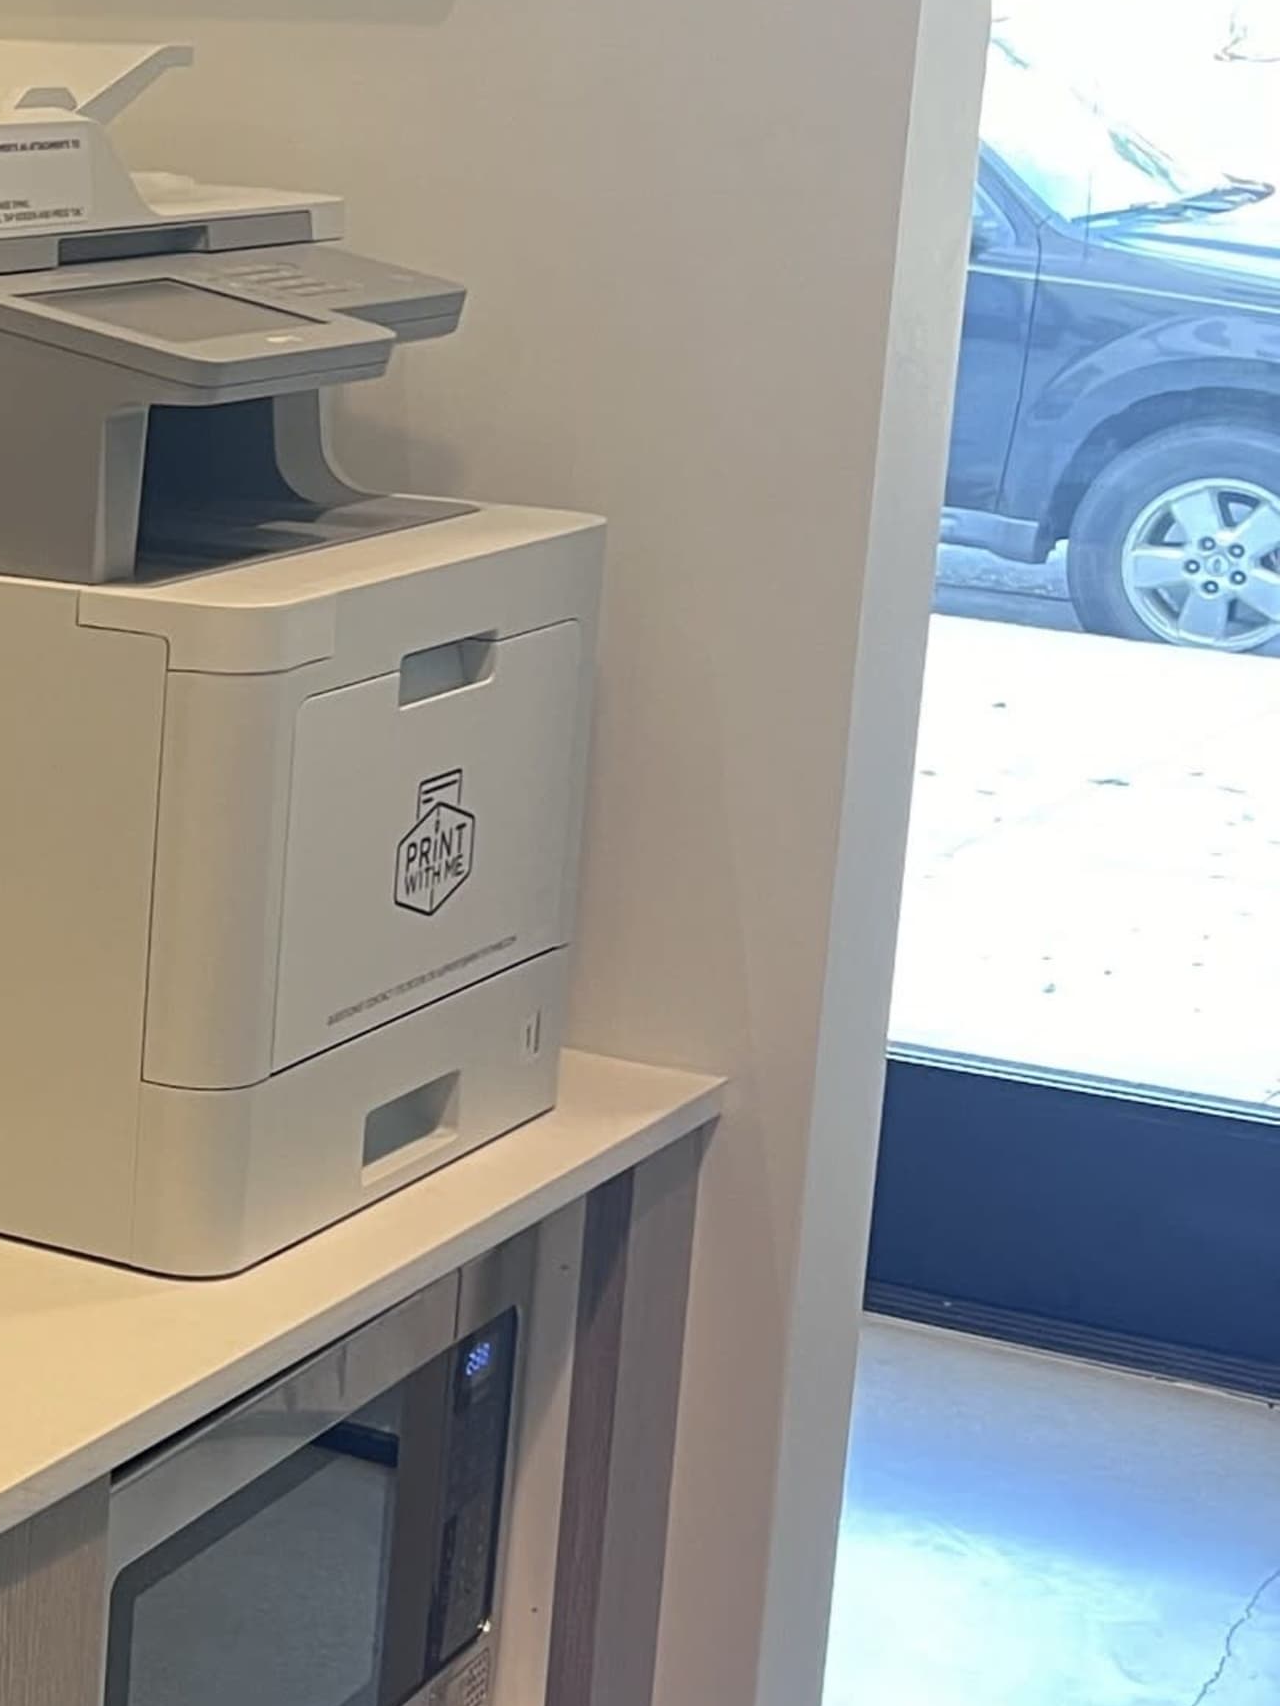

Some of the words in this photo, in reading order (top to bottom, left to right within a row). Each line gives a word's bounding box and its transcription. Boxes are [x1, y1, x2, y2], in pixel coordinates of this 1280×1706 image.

[406, 822, 467, 873] PRINT
[404, 865, 441, 896] WITH
[444, 854, 465, 881] ME
